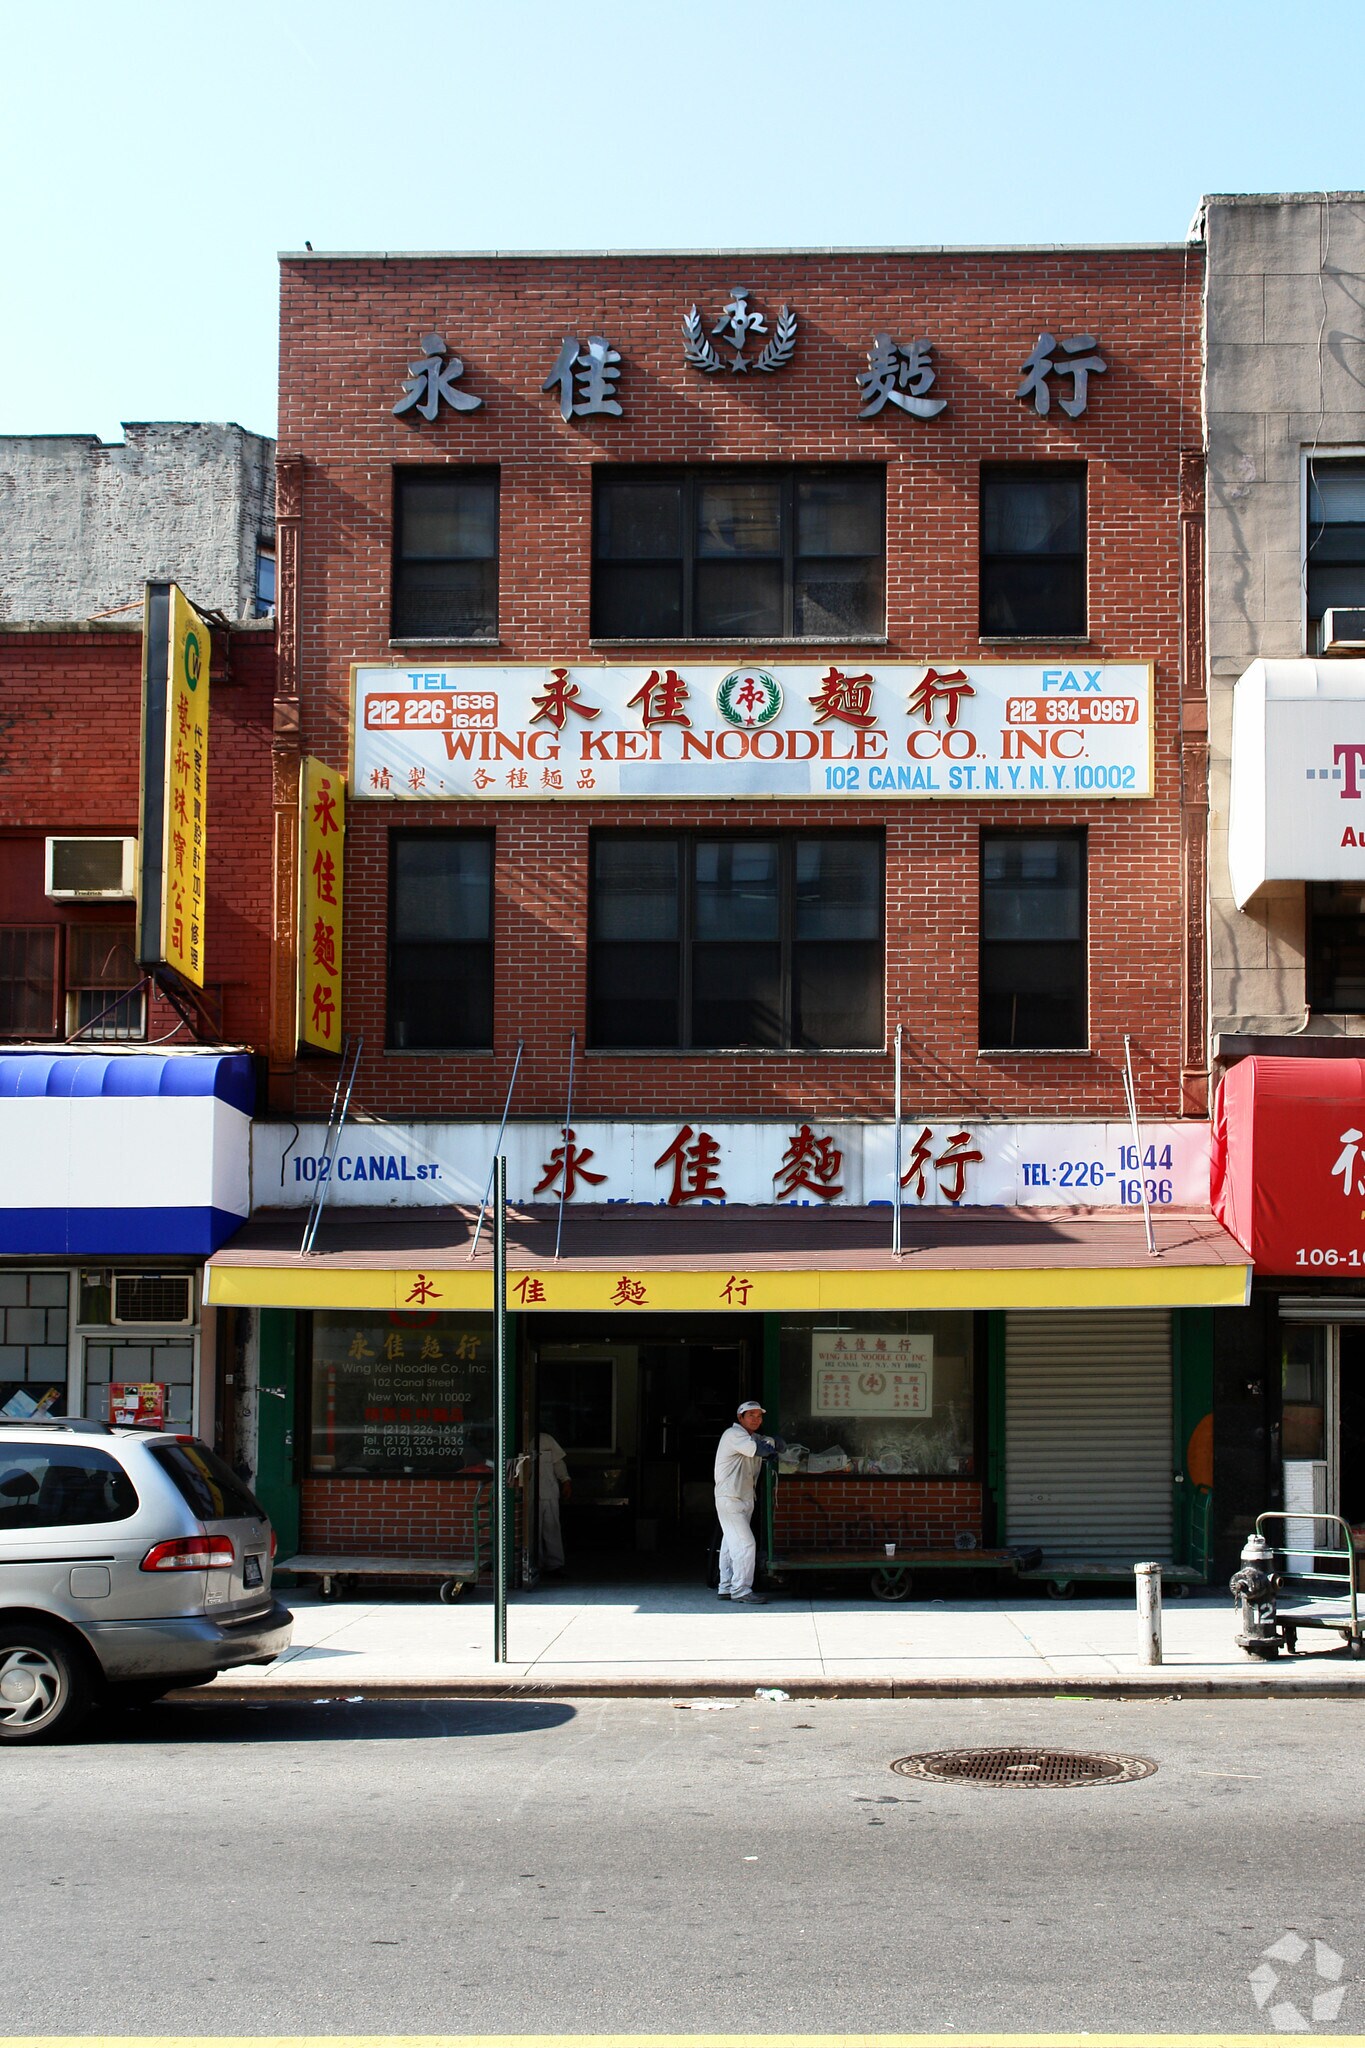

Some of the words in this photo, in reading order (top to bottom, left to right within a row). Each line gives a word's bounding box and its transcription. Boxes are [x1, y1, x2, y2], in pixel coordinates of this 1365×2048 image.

[407, 673, 458, 691] TEL
[1042, 670, 1102, 693] FAX
[368, 700, 400, 725] 212
[1009, 701, 1037, 723] 212
[1046, 699, 1137, 723] 334-0967
[443, 730, 561, 761] WING
[580, 730, 663, 761] KEI
[682, 729, 889, 761] NOODLE
[906, 728, 987, 761] CO.,
[1001, 728, 1090, 760] INC.
[825, 766, 861, 791] 102
[868, 765, 941, 791] CANAL
[1074, 764, 1136, 789] 10002
[1118, 1144, 1173, 1170] 1644
[293, 1156, 332, 1181] 102
[1119, 1179, 1173, 1204] 1636
[1296, 1248, 1365, 1266] 106-1
[342, 1363, 371, 1375] Wing
[375, 1363, 392, 1373] Kei
[395, 1363, 438, 1373] Noodle
[373, 1378, 390, 1387] 102
[393, 1378, 424, 1387] Canal
[426, 1378, 455, 1387] Street
[368, 1392, 390, 1402] New
[421, 1392, 436, 1402] NY
[440, 1392, 471, 1402] 10002
[383, 1424, 411, 1435] (212)
[413, 1424, 464, 1434] 226-1644
[363, 1436, 380, 1445] Tel.
[383, 1435, 411, 1446] (212)
[413, 1436, 464, 1445] 226-1636
[386, 1446, 413, 1457] (212)
[416, 1447, 464, 1456] 334-0967
